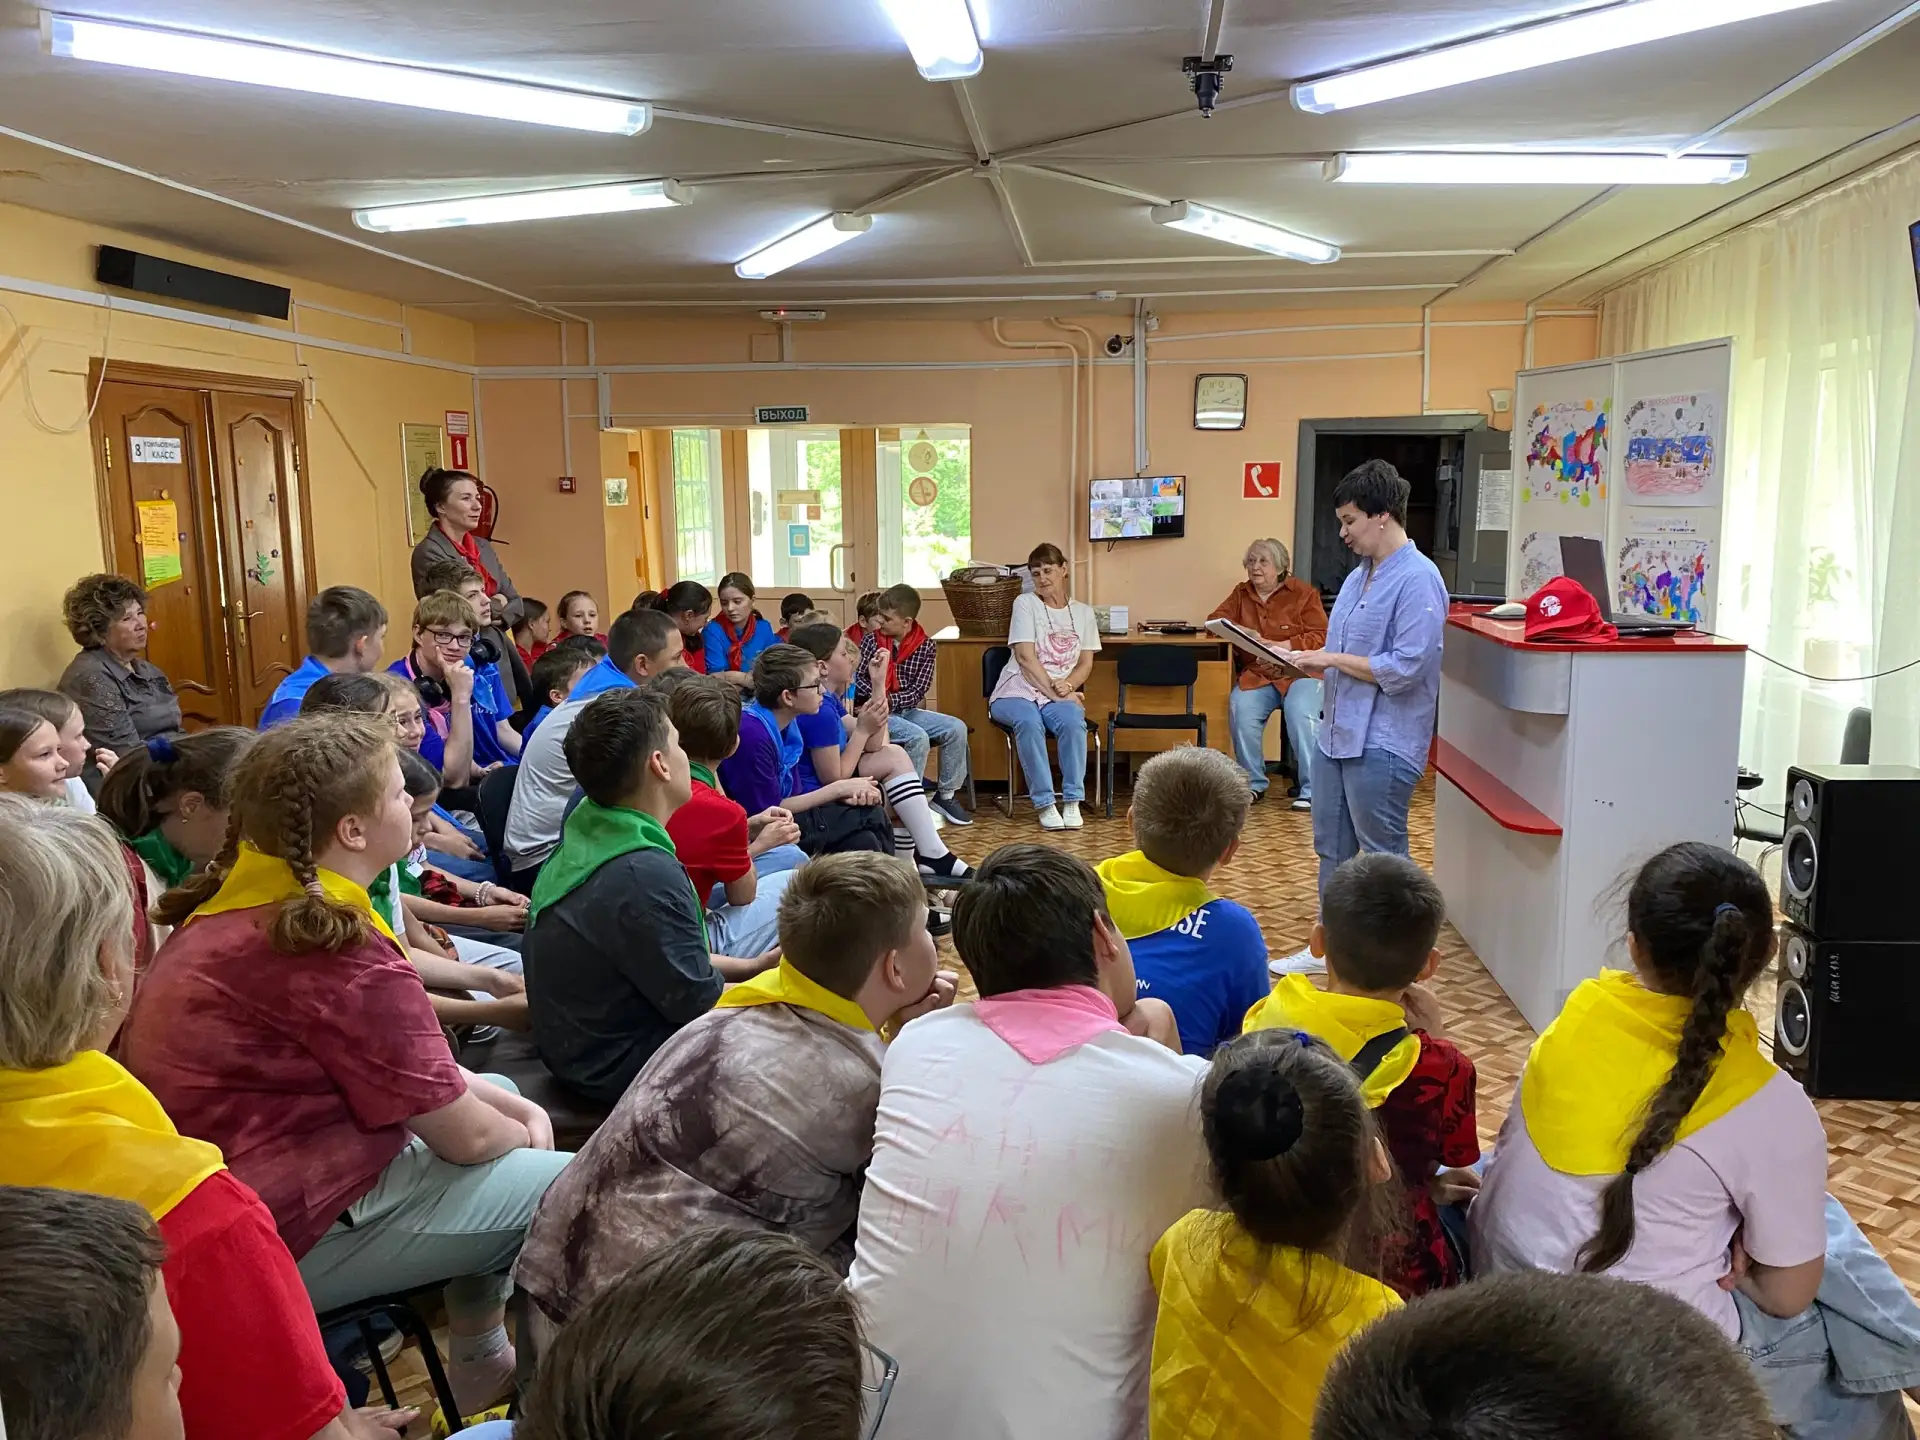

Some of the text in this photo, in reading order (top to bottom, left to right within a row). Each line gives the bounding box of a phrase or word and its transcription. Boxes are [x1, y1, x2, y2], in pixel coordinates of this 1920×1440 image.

[761, 409, 805, 420] ВЫХОД
[134, 443, 142, 457] 8
[151, 451, 175, 460] КЛАСС
[1169, 908, 1211, 940] SE
